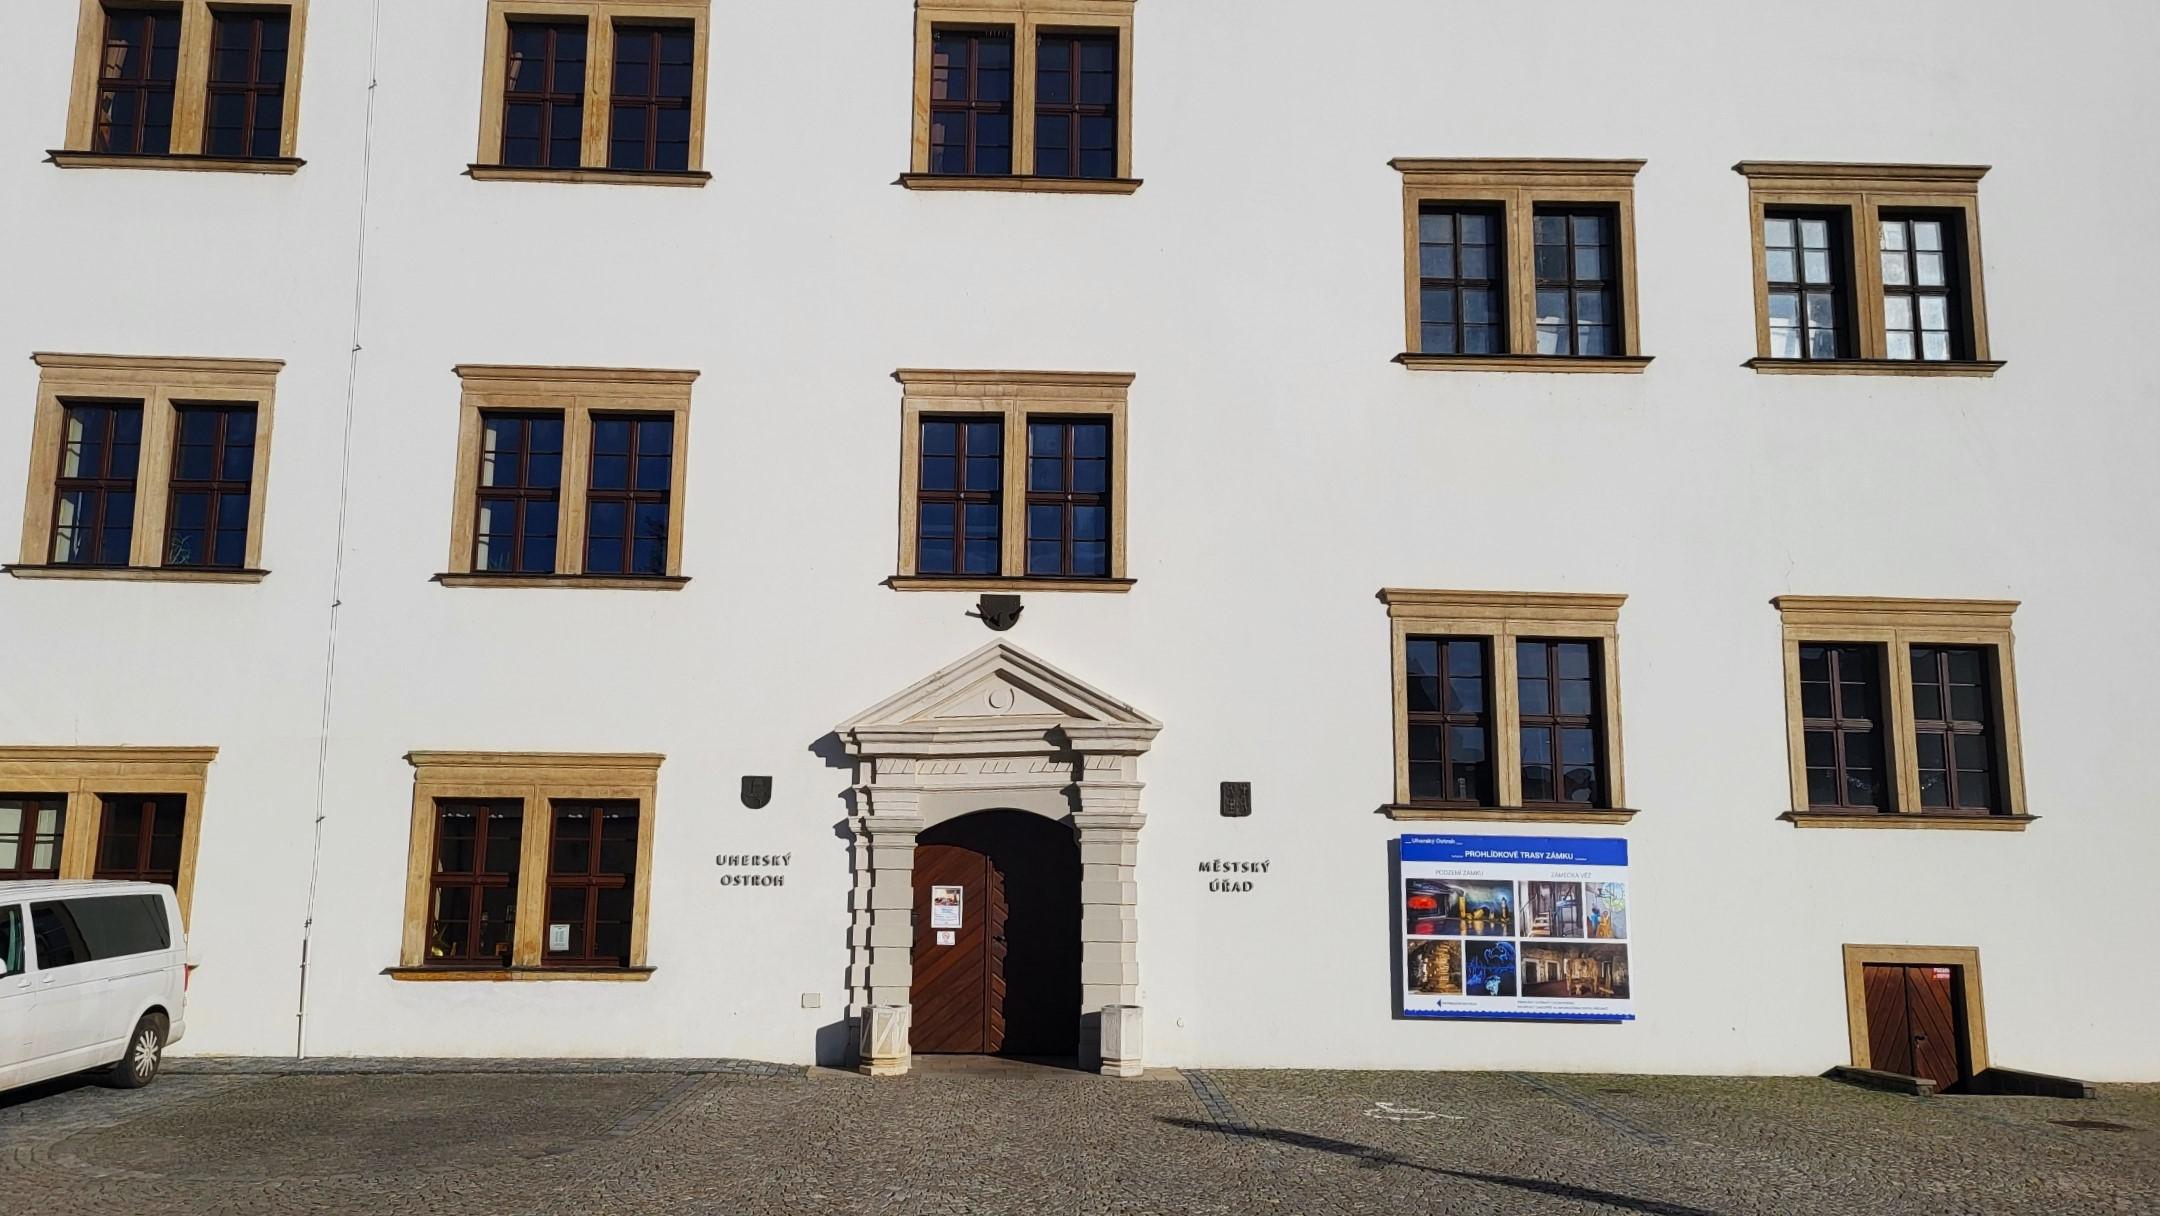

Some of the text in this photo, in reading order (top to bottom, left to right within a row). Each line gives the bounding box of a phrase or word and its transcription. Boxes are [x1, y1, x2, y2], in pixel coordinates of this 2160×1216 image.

[715, 851, 791, 866] UHERSKÝ
[1464, 849, 1574, 860] PROHLÍDKOVÉ TRASY ZÁMKU
[1198, 859, 1270, 873] MĚSTSKÝ
[719, 874, 785, 887] OSTROH
[1208, 878, 1254, 892] ÚŘAD
